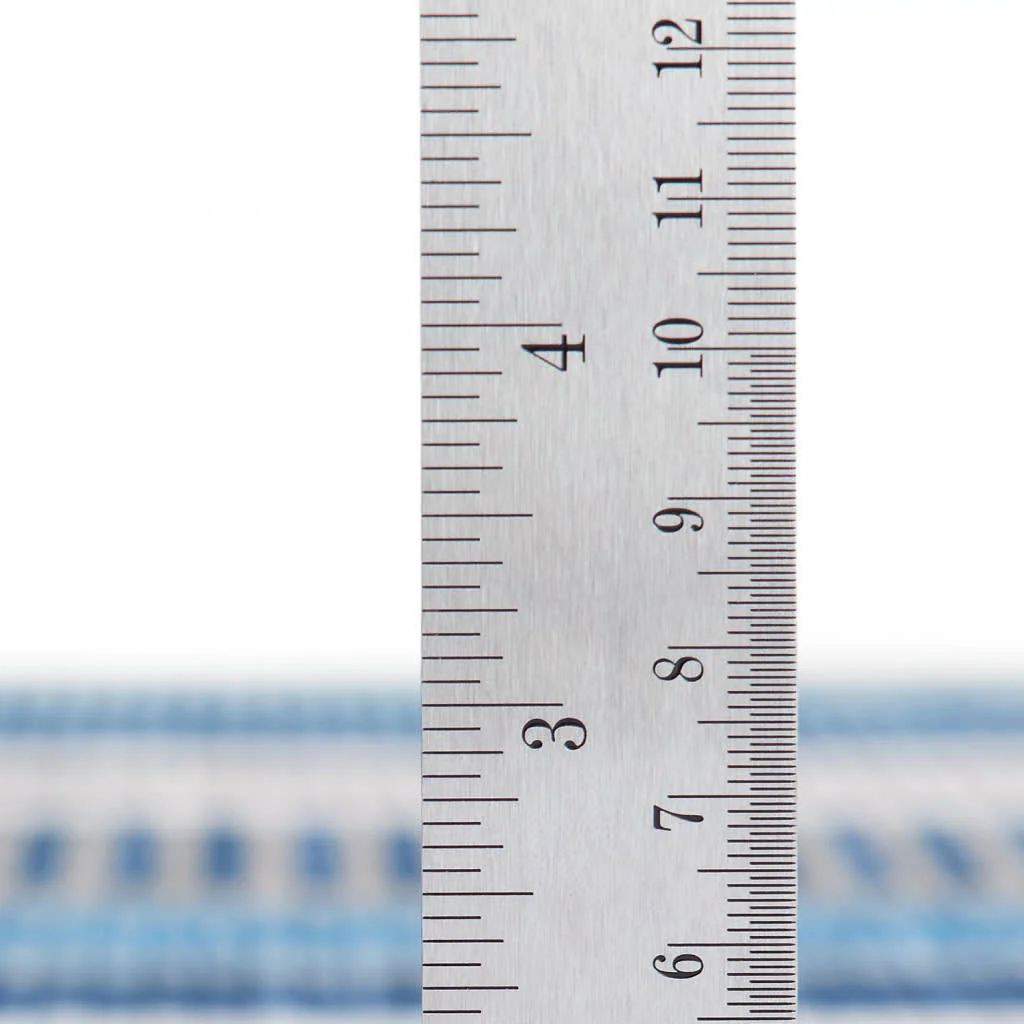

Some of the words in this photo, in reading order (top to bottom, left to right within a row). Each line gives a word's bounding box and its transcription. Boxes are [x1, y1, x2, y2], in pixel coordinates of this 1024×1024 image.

[652, 18, 703, 78] 12
[652, 168, 703, 228] 11
[521, 333, 586, 372] 4
[652, 317, 704, 379] 10
[652, 507, 704, 533] 9
[652, 656, 704, 682] 8
[521, 717, 587, 750] 3
[653, 804, 704, 831] 7
[652, 953, 704, 979] 6
